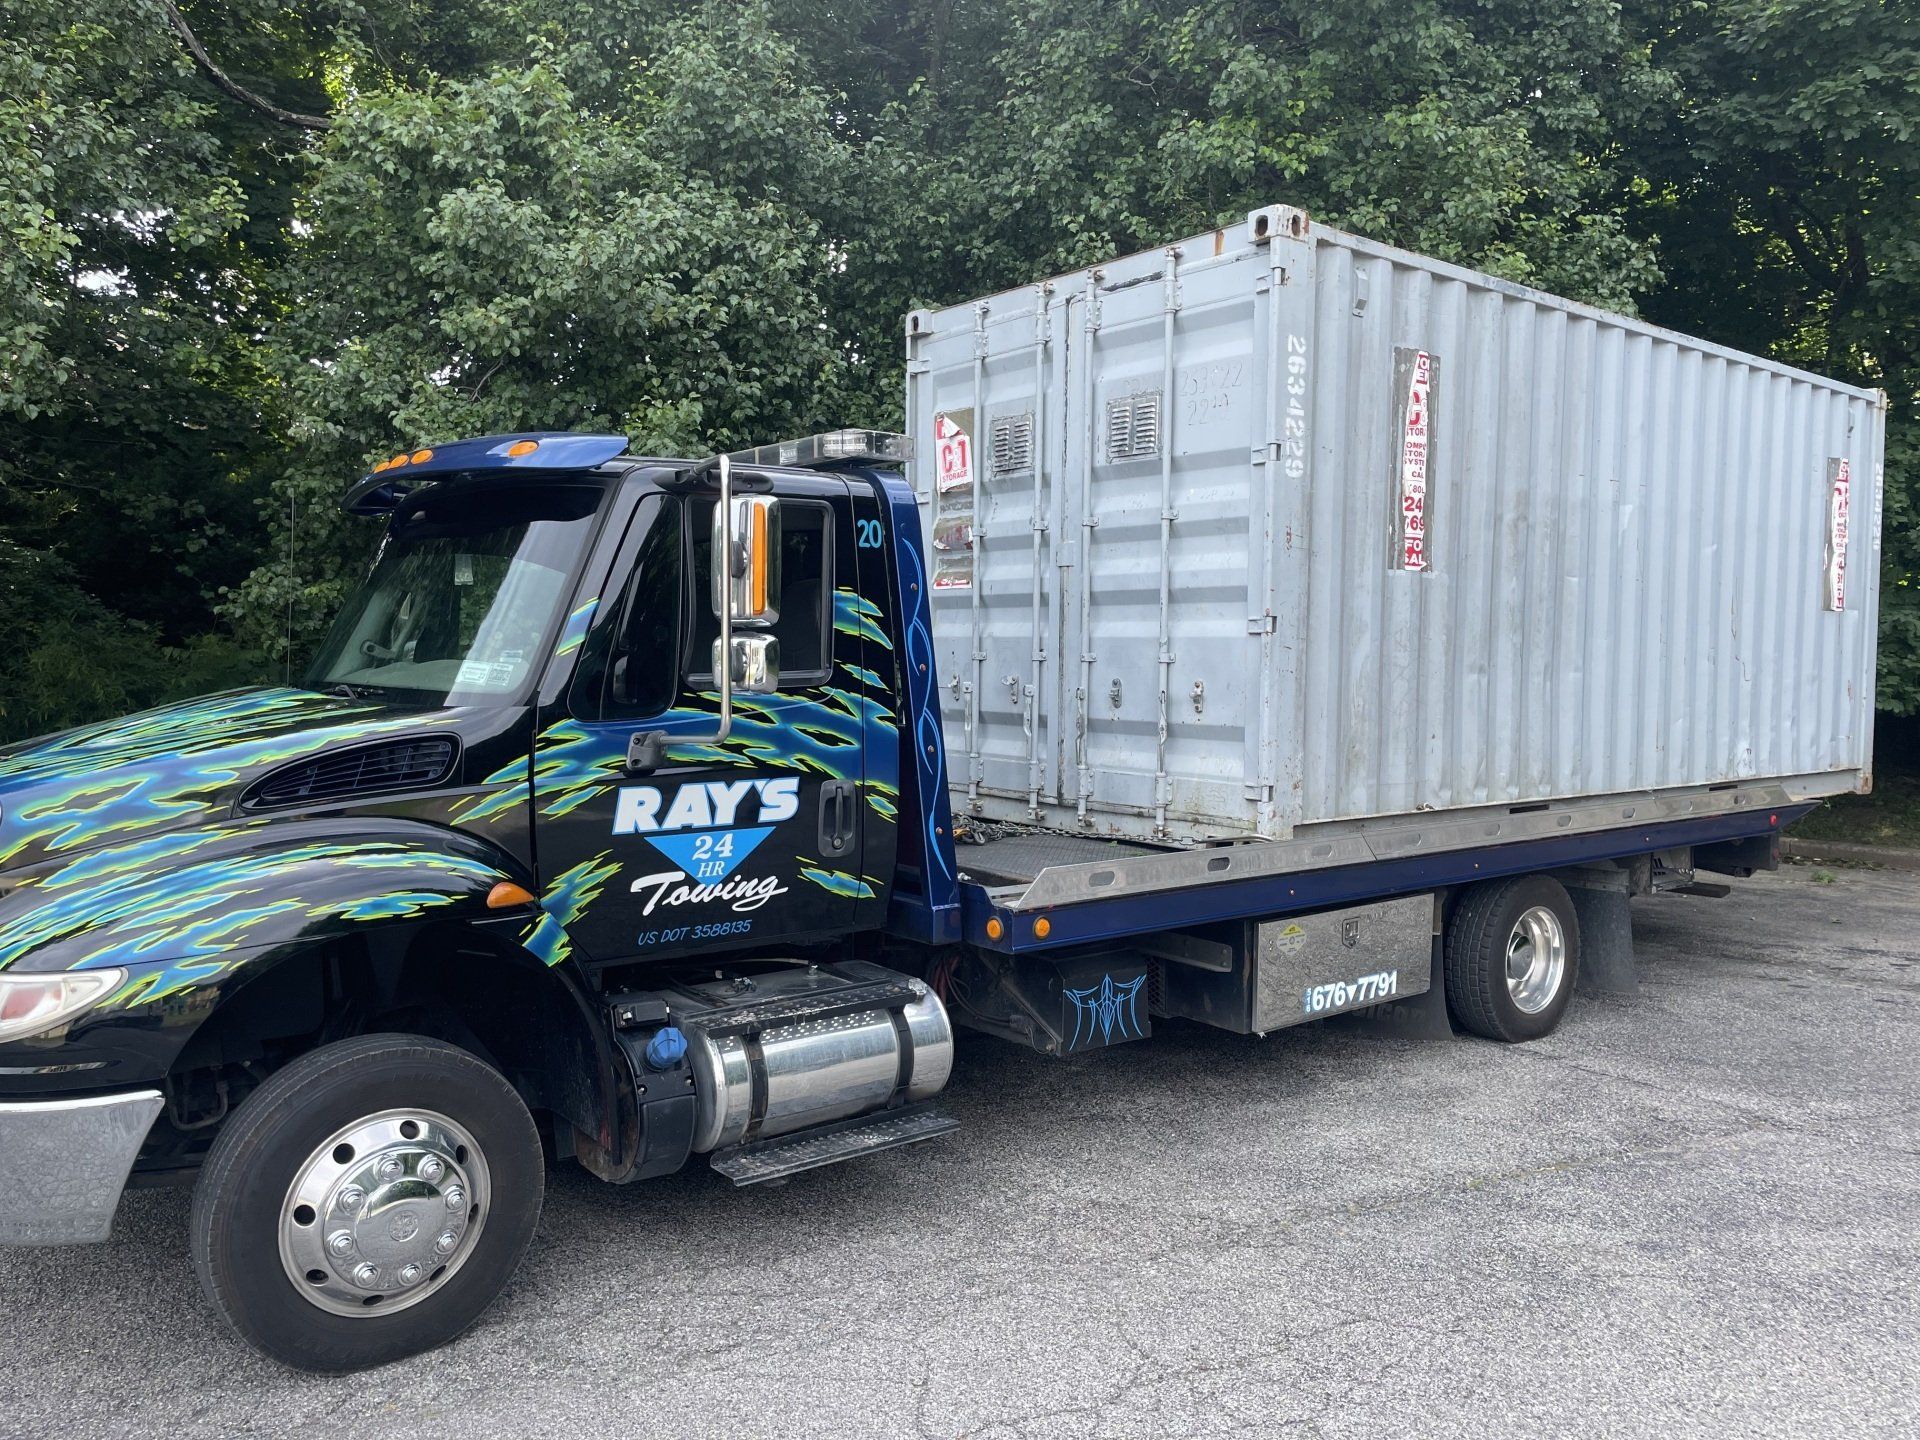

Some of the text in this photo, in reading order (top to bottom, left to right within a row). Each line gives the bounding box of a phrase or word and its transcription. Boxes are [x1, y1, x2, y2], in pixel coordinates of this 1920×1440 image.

[1285, 334, 1307, 479] 2634229
[942, 469, 968, 482] STORAGE
[857, 519, 882, 548] 20
[1404, 514, 1425, 531] 69
[612, 776, 800, 835] RAY'S
[692, 833, 734, 861] 24
[697, 861, 726, 877] HR
[630, 870, 789, 917] Towing
[638, 919, 753, 946] US DOT 3588135
